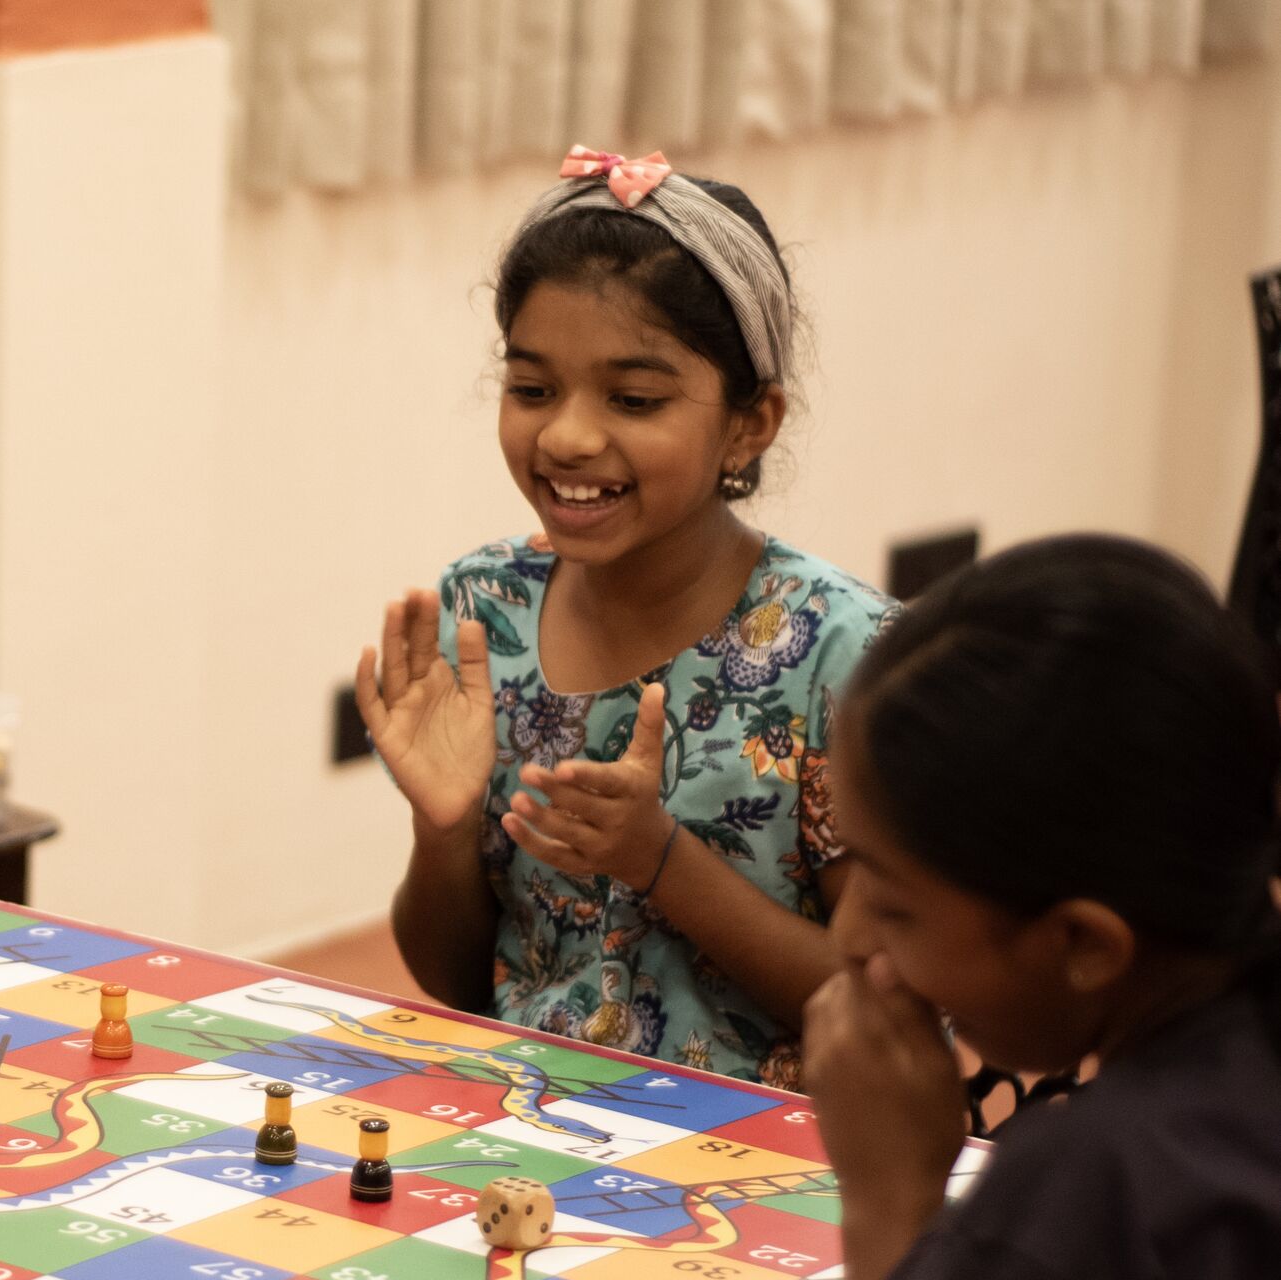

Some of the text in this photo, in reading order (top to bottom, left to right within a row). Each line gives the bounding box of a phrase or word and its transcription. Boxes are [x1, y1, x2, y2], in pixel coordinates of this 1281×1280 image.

[28, 926, 62, 937] 9
[147, 954, 181, 968] 8
[52, 980, 100, 996] 13
[260, 983, 296, 994] 7
[165, 1009, 222, 1025] 14
[383, 1014, 418, 1023] 6
[510, 1044, 548, 1057] 5
[292, 1072, 355, 1089] 15
[644, 1077, 678, 1089] 4
[322, 1104, 386, 1122] 25
[421, 1104, 485, 1123] 16
[783, 1111, 817, 1123] 3
[140, 1113, 206, 1132] 35
[453, 1137, 519, 1158] 24
[563, 1146, 624, 1160] 17
[697, 1141, 757, 1160] 18
[212, 1167, 281, 1188] 36
[593, 1175, 659, 1196] 23
[407, 1187, 478, 1207] 37
[109, 1205, 173, 1225] 45
[253, 1208, 318, 1227] 44
[58, 1220, 128, 1243] 56
[749, 1245, 819, 1268] 22
[673, 1260, 742, 1280] 39
